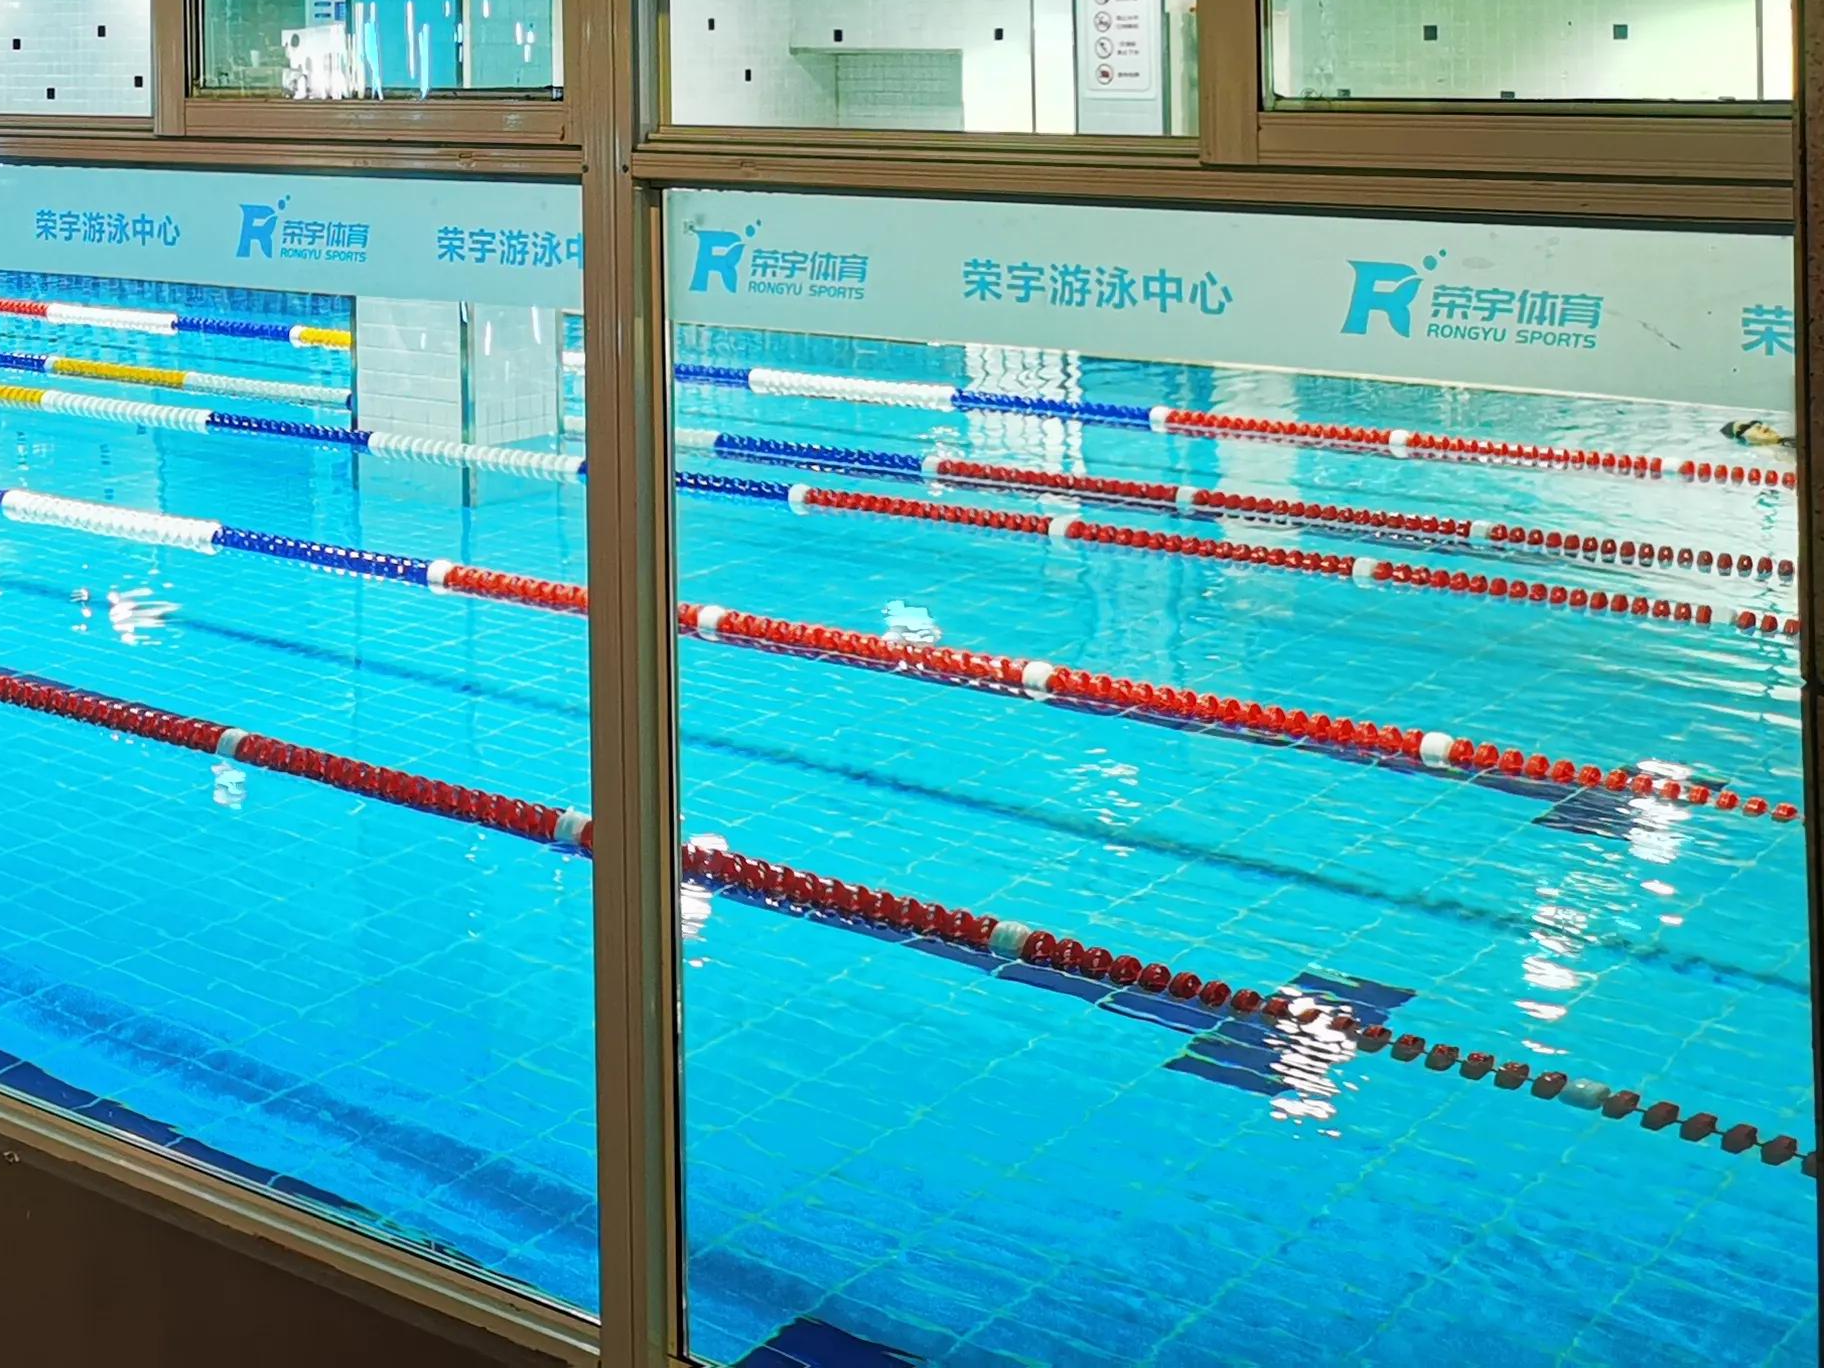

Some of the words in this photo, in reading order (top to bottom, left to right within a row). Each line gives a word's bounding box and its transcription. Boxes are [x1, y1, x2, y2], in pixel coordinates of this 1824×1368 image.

[35, 209, 180, 247] 荣宇游泳中心
[282, 220, 370, 248] 荣宇体育
[280, 247, 322, 261] RONGYU
[325, 249, 367, 263] SPORTS
[750, 248, 869, 283] 荣宇体育
[748, 280, 803, 296] RONGYU
[808, 284, 865, 300] SPORTS
[962, 258, 1233, 316] 荣宇游泳中心
[1430, 284, 1604, 329] 荣宇体育
[1426, 322, 1506, 343] RONGYU
[1515, 328, 1597, 350] SPORTS
